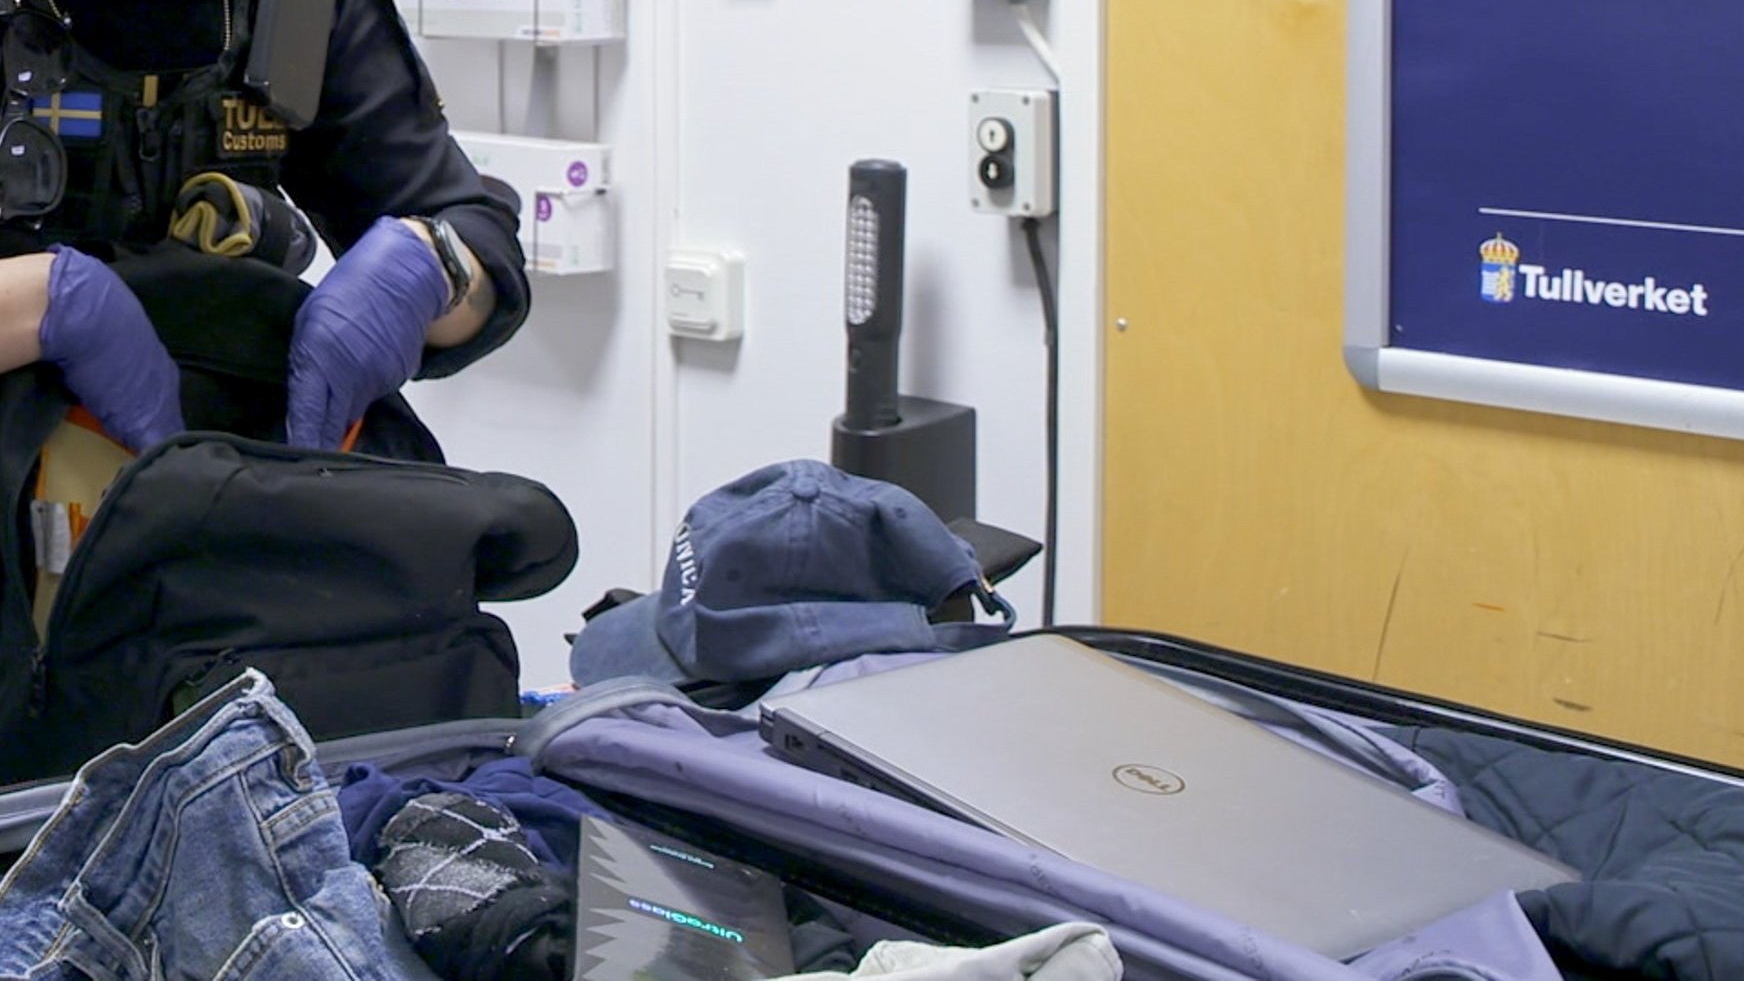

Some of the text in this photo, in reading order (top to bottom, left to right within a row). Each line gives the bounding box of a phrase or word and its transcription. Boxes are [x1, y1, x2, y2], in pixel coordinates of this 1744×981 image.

[222, 98, 285, 131] TUL
[222, 130, 287, 151] Customs
[1518, 263, 1709, 317] Tullverket
[628, 898, 744, 944] UltraGlass
